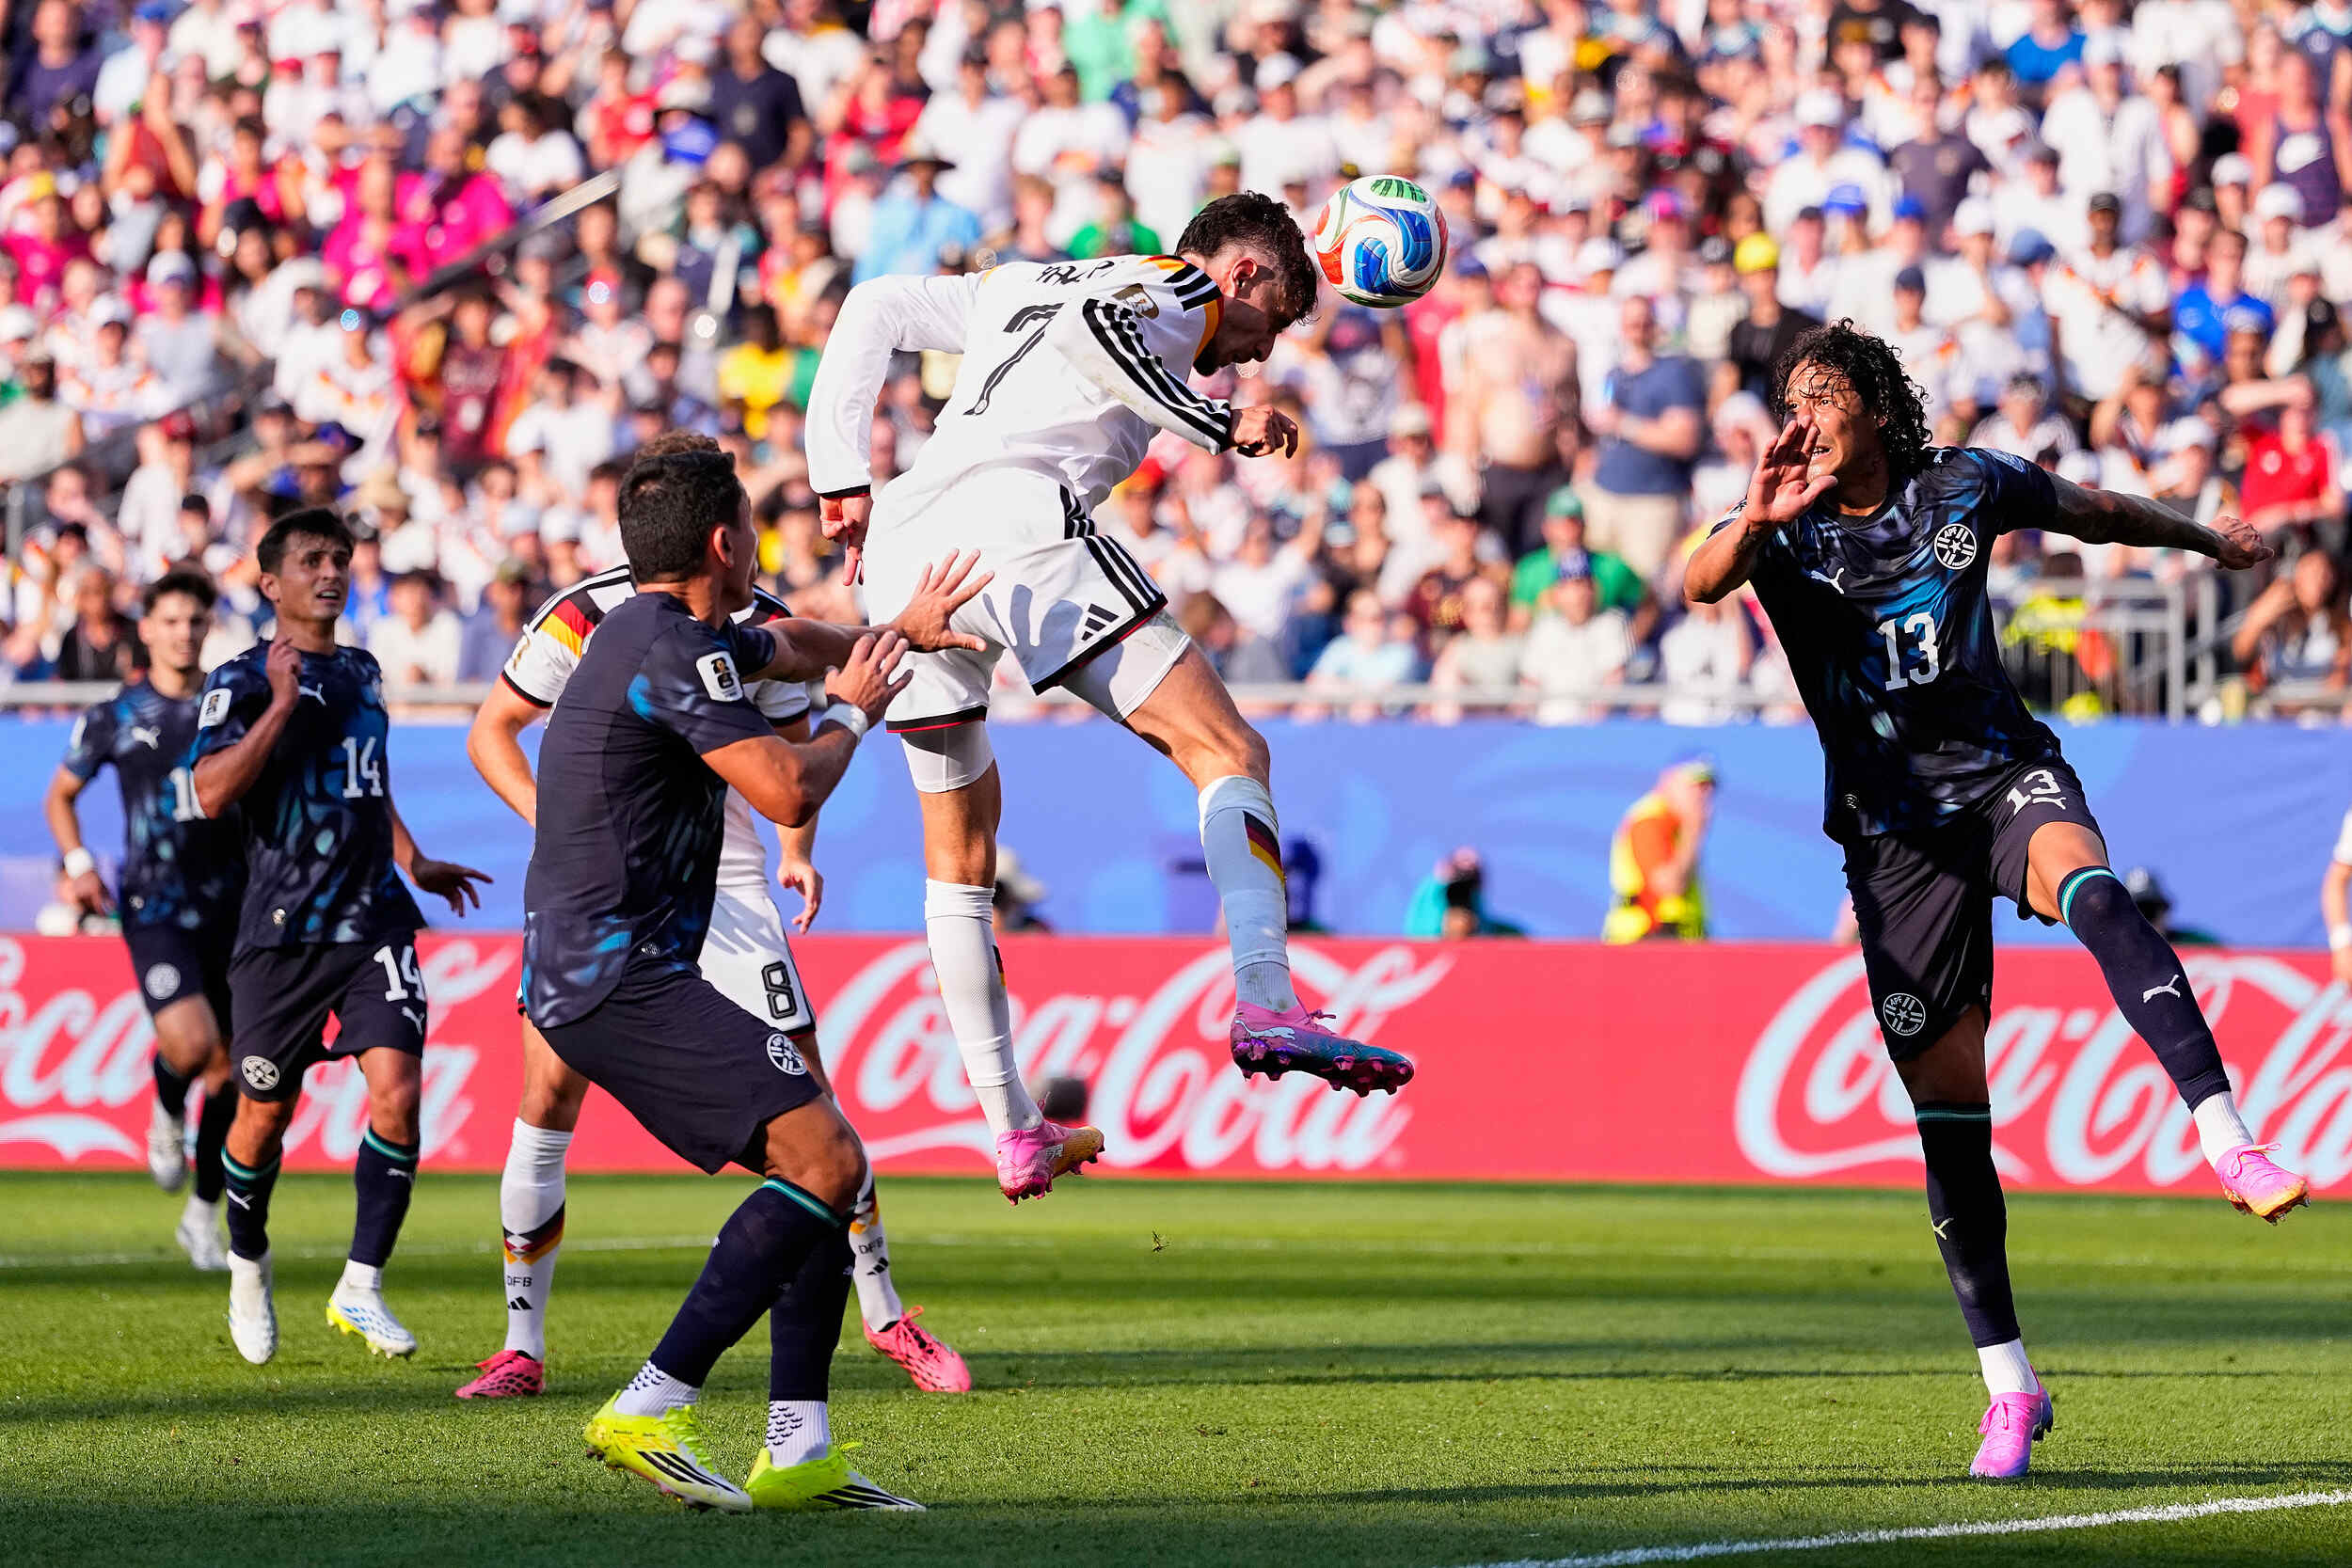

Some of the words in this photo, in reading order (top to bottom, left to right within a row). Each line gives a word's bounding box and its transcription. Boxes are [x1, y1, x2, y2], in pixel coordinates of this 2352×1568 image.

[962, 302, 1065, 416] 7
[1876, 611, 1939, 690] 13
[168, 767, 208, 823] 1
[342, 736, 384, 799] 14
[2006, 769, 2061, 816] 13
[373, 944, 427, 1003] 14
[761, 960, 798, 1020] 8
